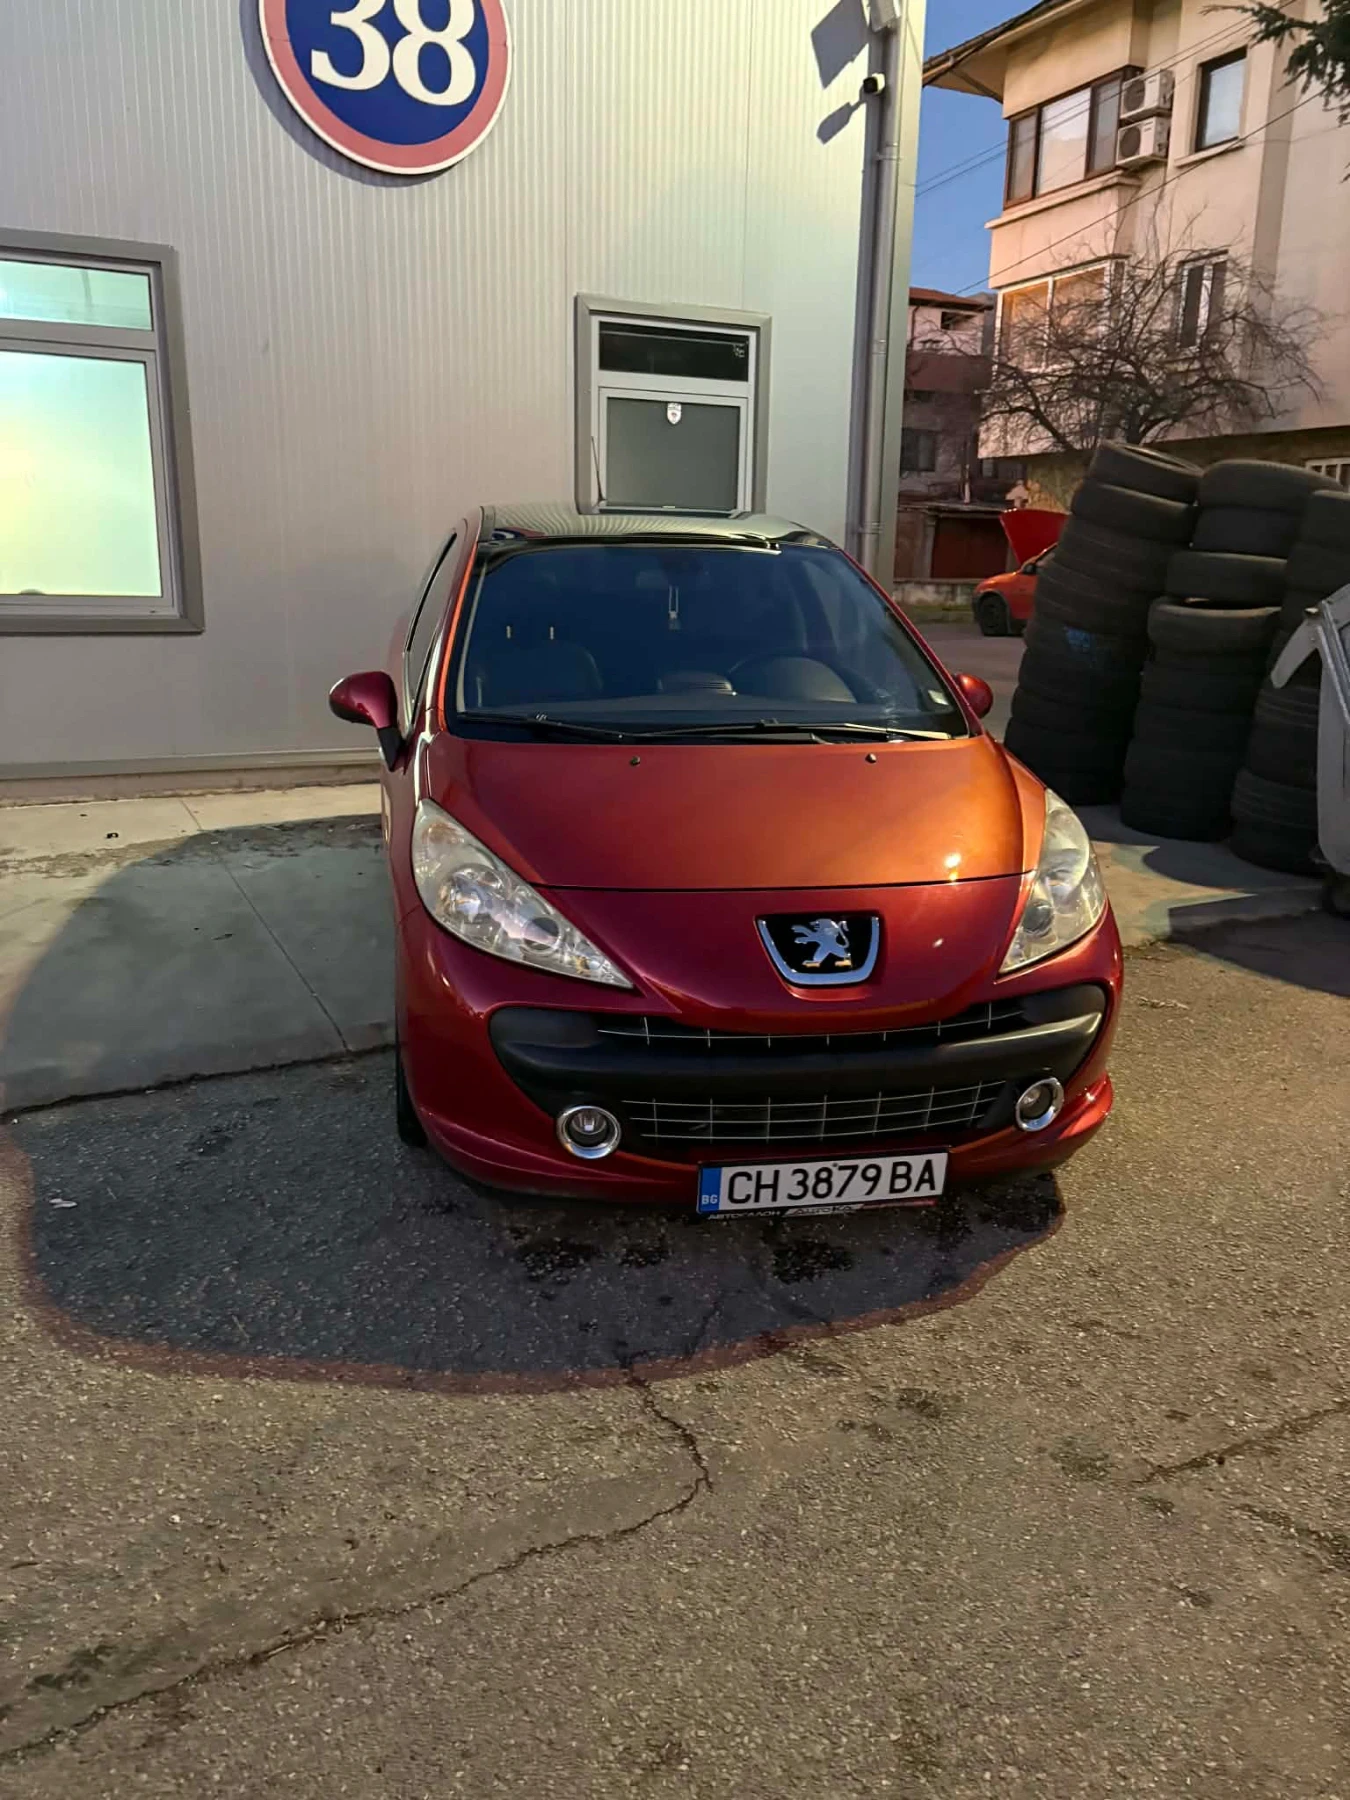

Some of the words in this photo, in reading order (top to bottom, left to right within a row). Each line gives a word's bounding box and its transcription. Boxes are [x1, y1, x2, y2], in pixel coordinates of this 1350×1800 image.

[311, 0, 476, 106] 38
[701, 1194, 718, 1205] BG
[727, 1169, 780, 1204] CH
[787, 1163, 882, 1201] 3879
[889, 1159, 936, 1195] BA
